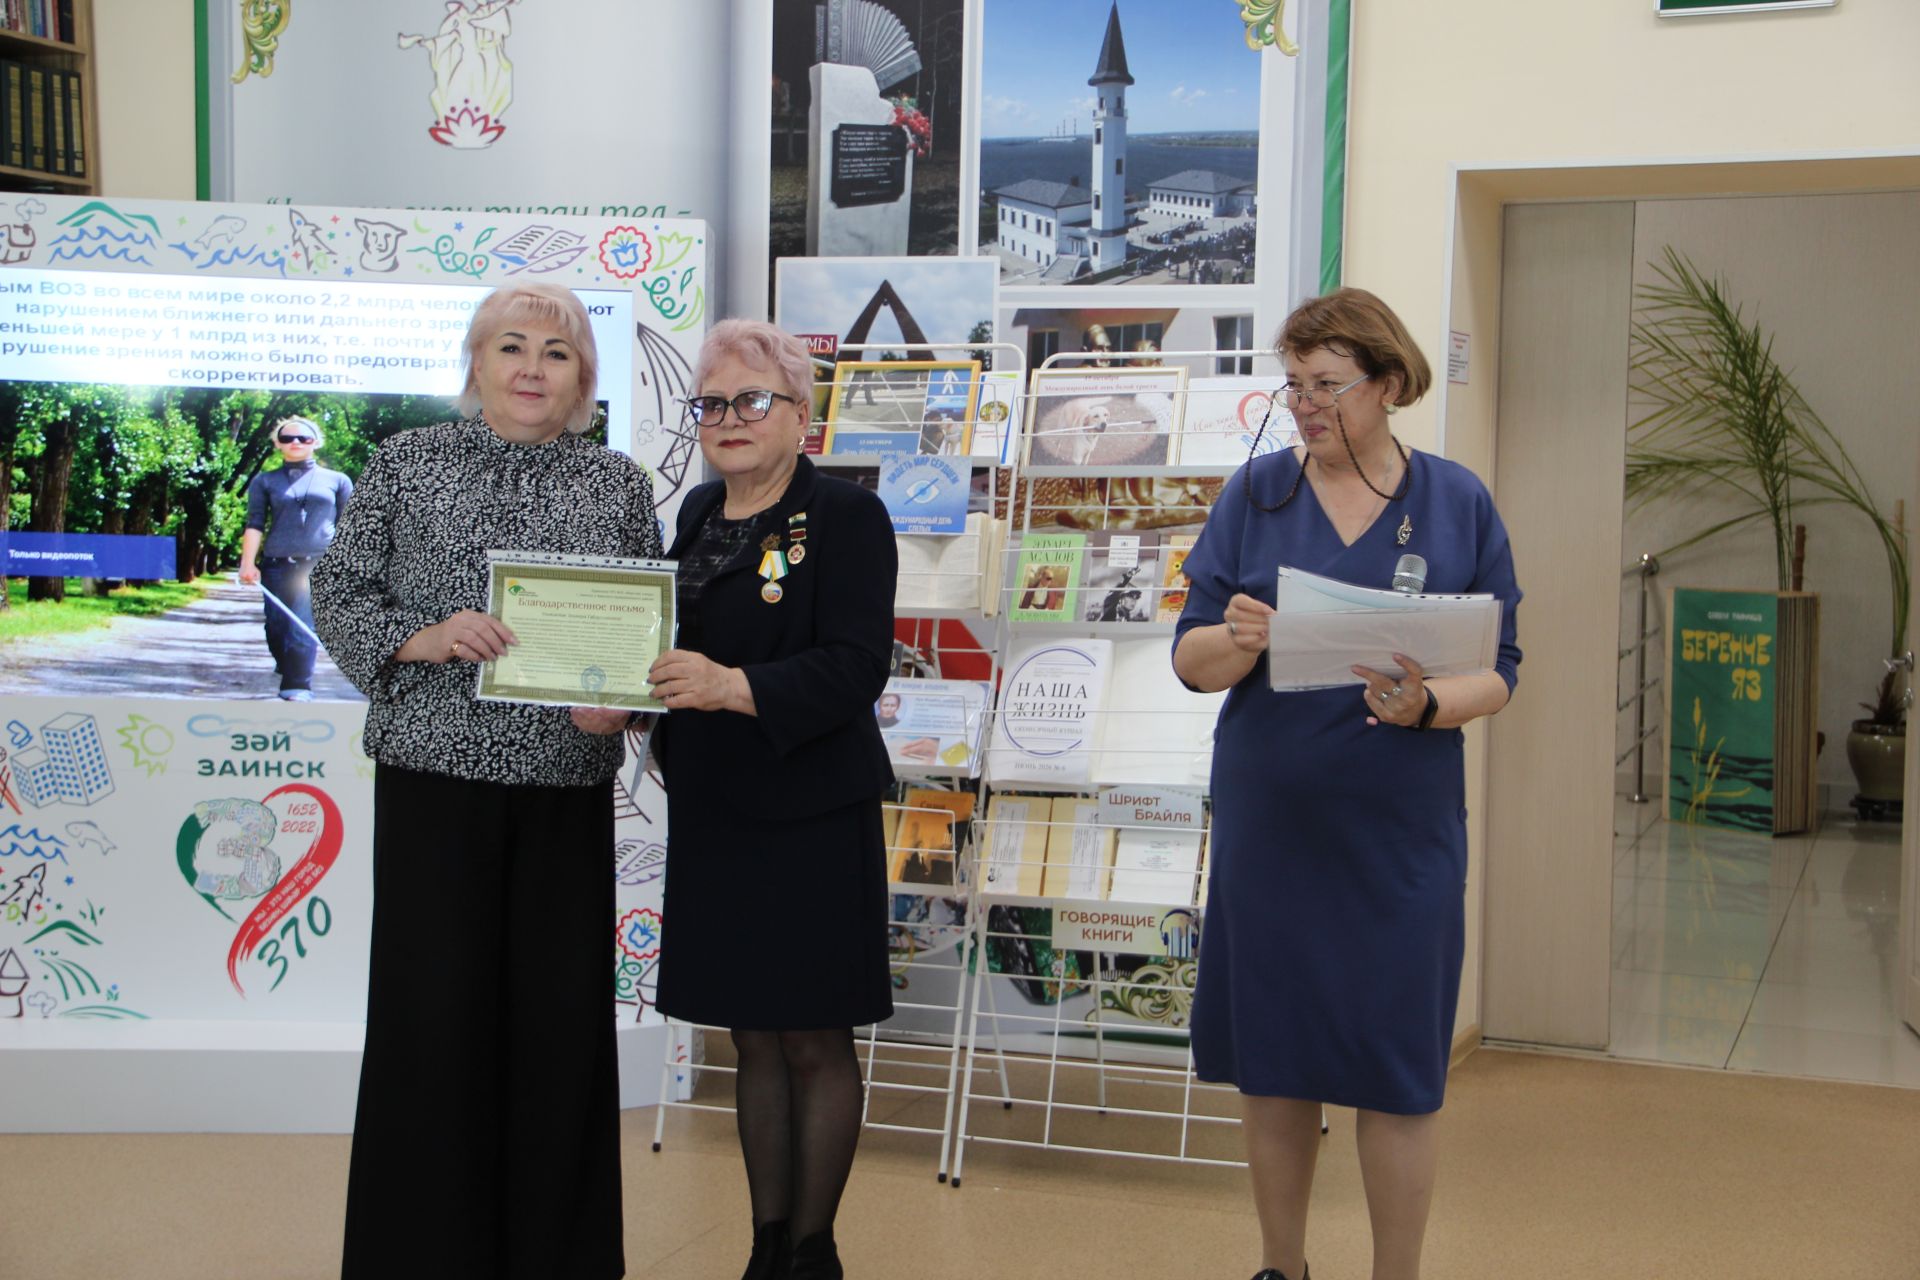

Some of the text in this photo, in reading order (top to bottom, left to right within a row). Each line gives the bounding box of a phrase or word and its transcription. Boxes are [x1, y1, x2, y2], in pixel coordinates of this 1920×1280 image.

[40, 281, 86, 295] ВОЗ
[94, 287, 121, 297] во
[127, 288, 182, 300] всем
[188, 291, 244, 304] мире
[250, 293, 316, 305] около
[320, 293, 351, 308] 2,2
[357, 297, 415, 311] млрд
[16, 302, 158, 320] нарушением
[163, 306, 268, 323] ближнего
[275, 313, 314, 325] или
[320, 314, 421, 329] дальнего
[91, 327, 147, 341] мере
[151, 329, 164, 342] у
[172, 327, 180, 339] 1
[189, 330, 247, 344] млрд
[252, 331, 276, 343] из
[283, 332, 327, 347] них,
[334, 335, 366, 347] т.е.
[373, 337, 435, 349] почти
[3, 341, 100, 356] рушение
[106, 346, 183, 360] зрения
[190, 350, 263, 363] можно
[269, 350, 328, 364] было
[168, 366, 364, 386] скорректировать.
[914, 456, 930, 466] МИР
[890, 515, 937, 525] ЕЖДУНАРОДНЫЙ
[9, 549, 94, 562] Только видеопоток
[518, 597, 645, 613] Благодарственное письмо
[1682, 629, 1771, 665] БЕРЕНЧЕ
[1017, 682, 1088, 699] НАША
[1732, 668, 1761, 700] ЯЗ
[1012, 702, 1086, 719] ЖИЗНЬ
[231, 731, 291, 752] ЗӘЙ
[197, 759, 326, 779] ЗАИНСК
[287, 803, 318, 816] 1652
[281, 821, 316, 833] 2022
[1060, 911, 1156, 928] ГОВОРЯЩИЕ
[257, 896, 333, 992] 370
[1082, 928, 1133, 943] КНИГИ
